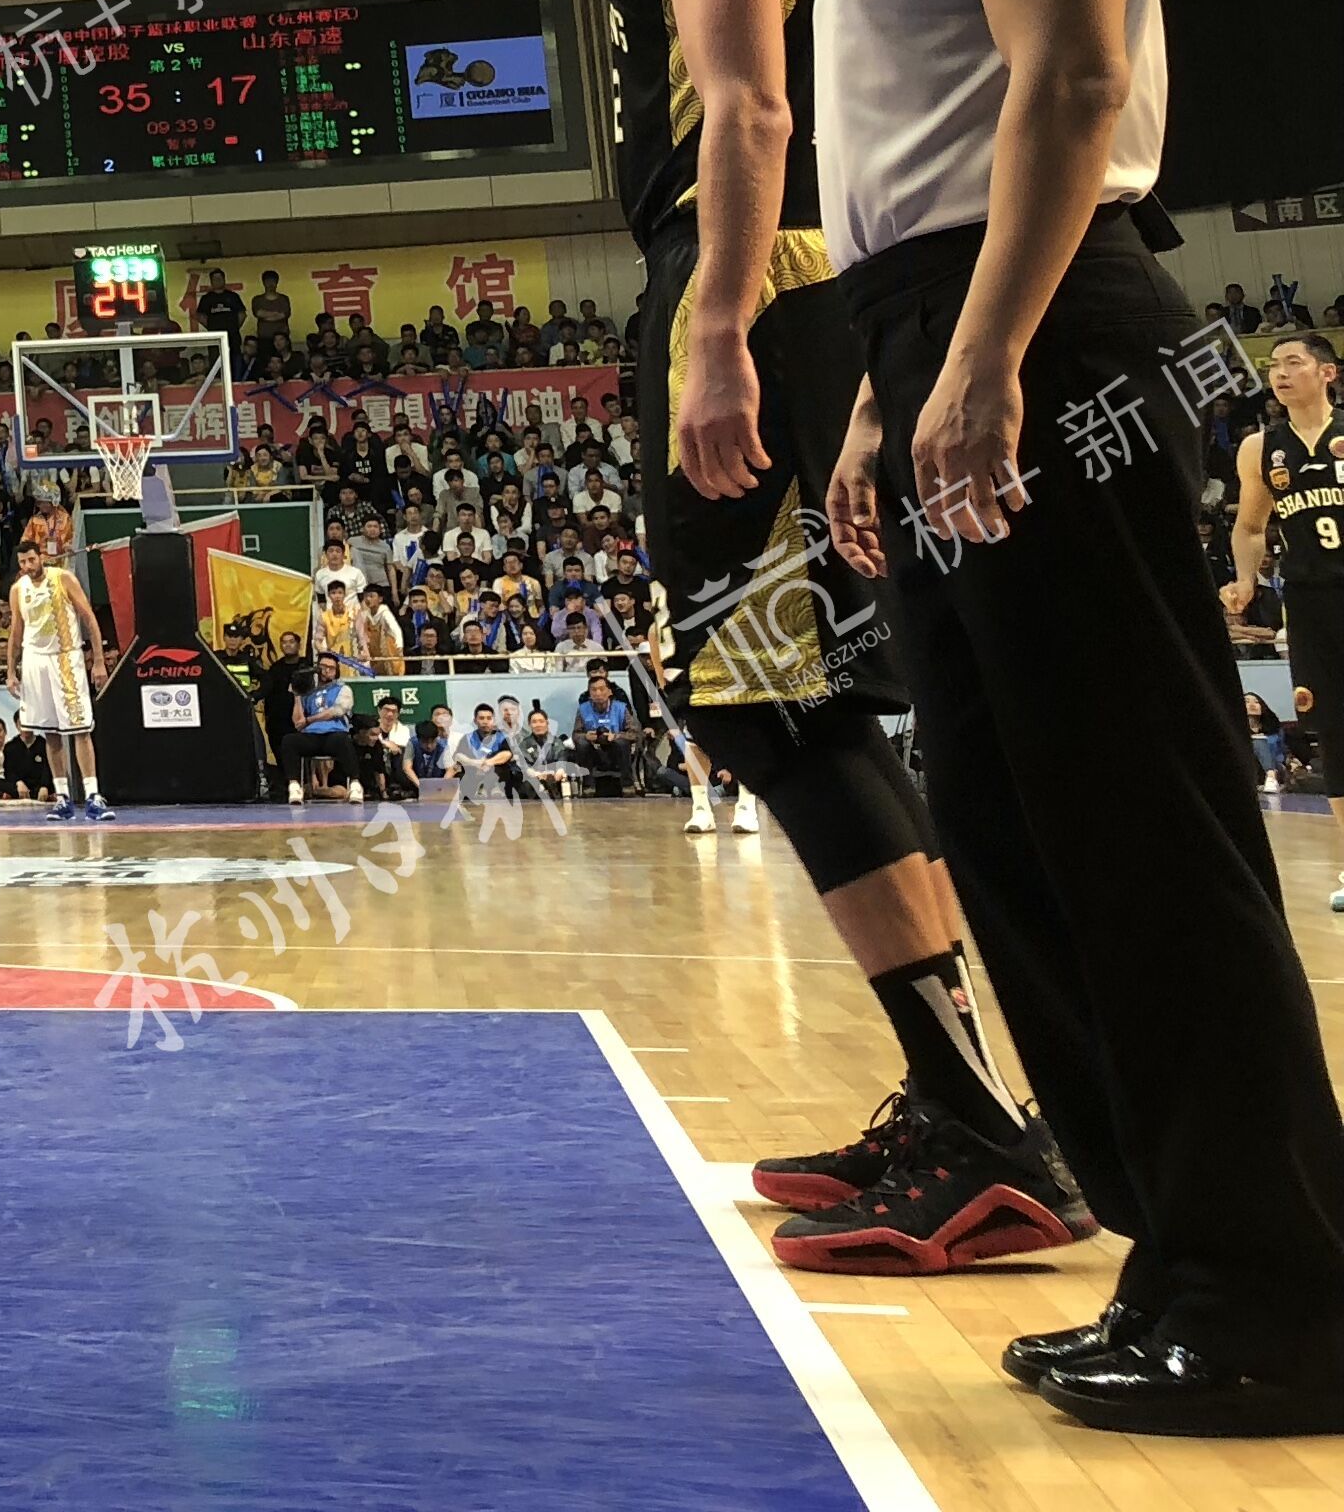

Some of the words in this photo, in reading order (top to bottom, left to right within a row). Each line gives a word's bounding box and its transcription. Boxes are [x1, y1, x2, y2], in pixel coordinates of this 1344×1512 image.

[242, 26, 344, 49] 山东高速
[99, 83, 151, 115] 35
[207, 75, 256, 106] 17
[103, 159, 114, 172] 2
[255, 149, 263, 162] 1
[1276, 192, 1343, 223] 南区
[93, 281, 146, 317] 24
[1315, 517, 1341, 550] 9
[136, 665, 203, 678] LI-NING
